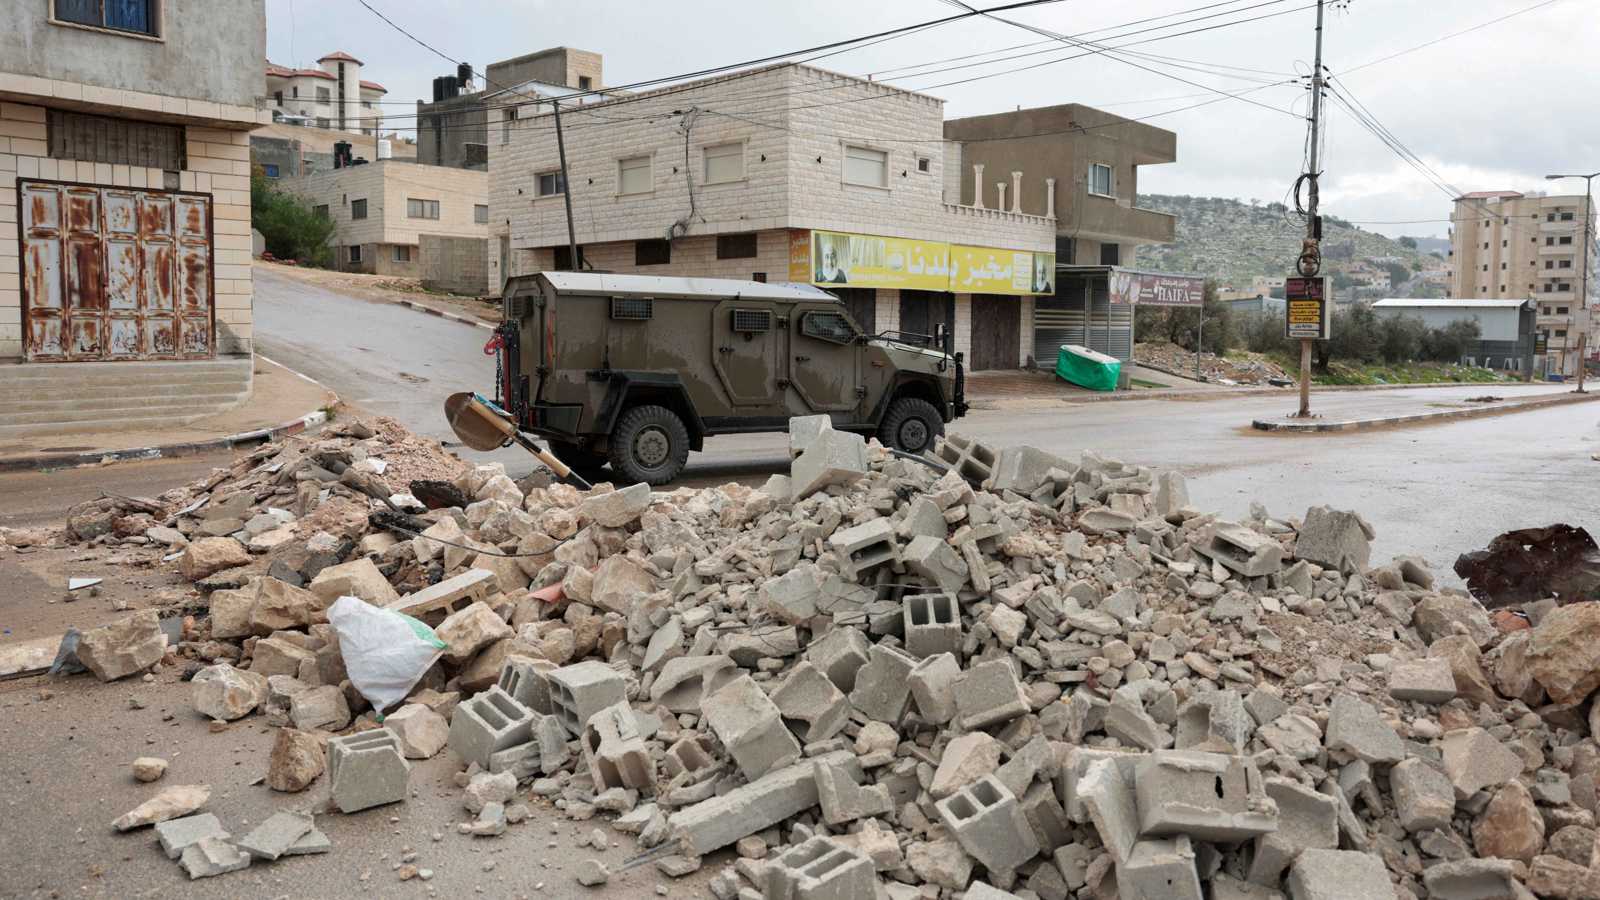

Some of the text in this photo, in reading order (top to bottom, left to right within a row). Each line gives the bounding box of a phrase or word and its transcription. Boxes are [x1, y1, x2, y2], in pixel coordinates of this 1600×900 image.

[903, 245, 958, 286] بلدنا
[962, 252, 1012, 287] مخبز
[1158, 287, 1190, 302] HAIFA
